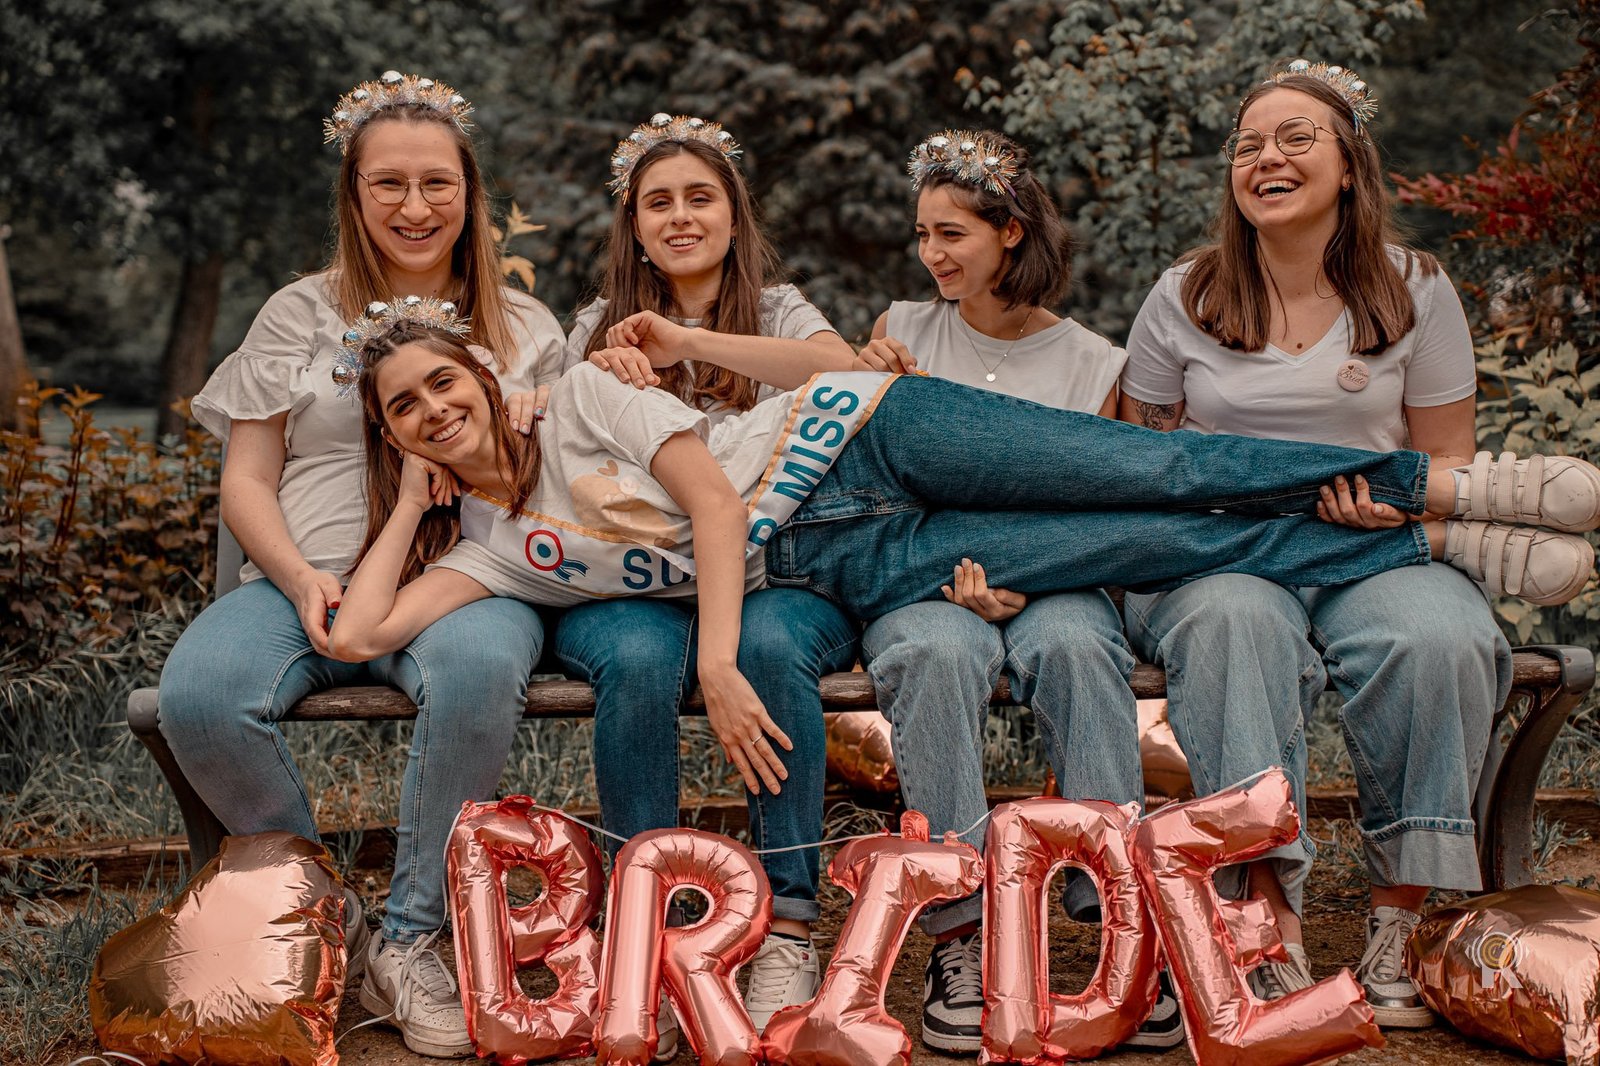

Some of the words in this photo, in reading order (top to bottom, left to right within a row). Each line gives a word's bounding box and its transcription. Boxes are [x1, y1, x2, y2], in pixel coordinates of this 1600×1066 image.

[1337, 368, 1366, 385] Bride
[772, 386, 860, 503] MISS
[446, 766, 1385, 1066] BRIDE
